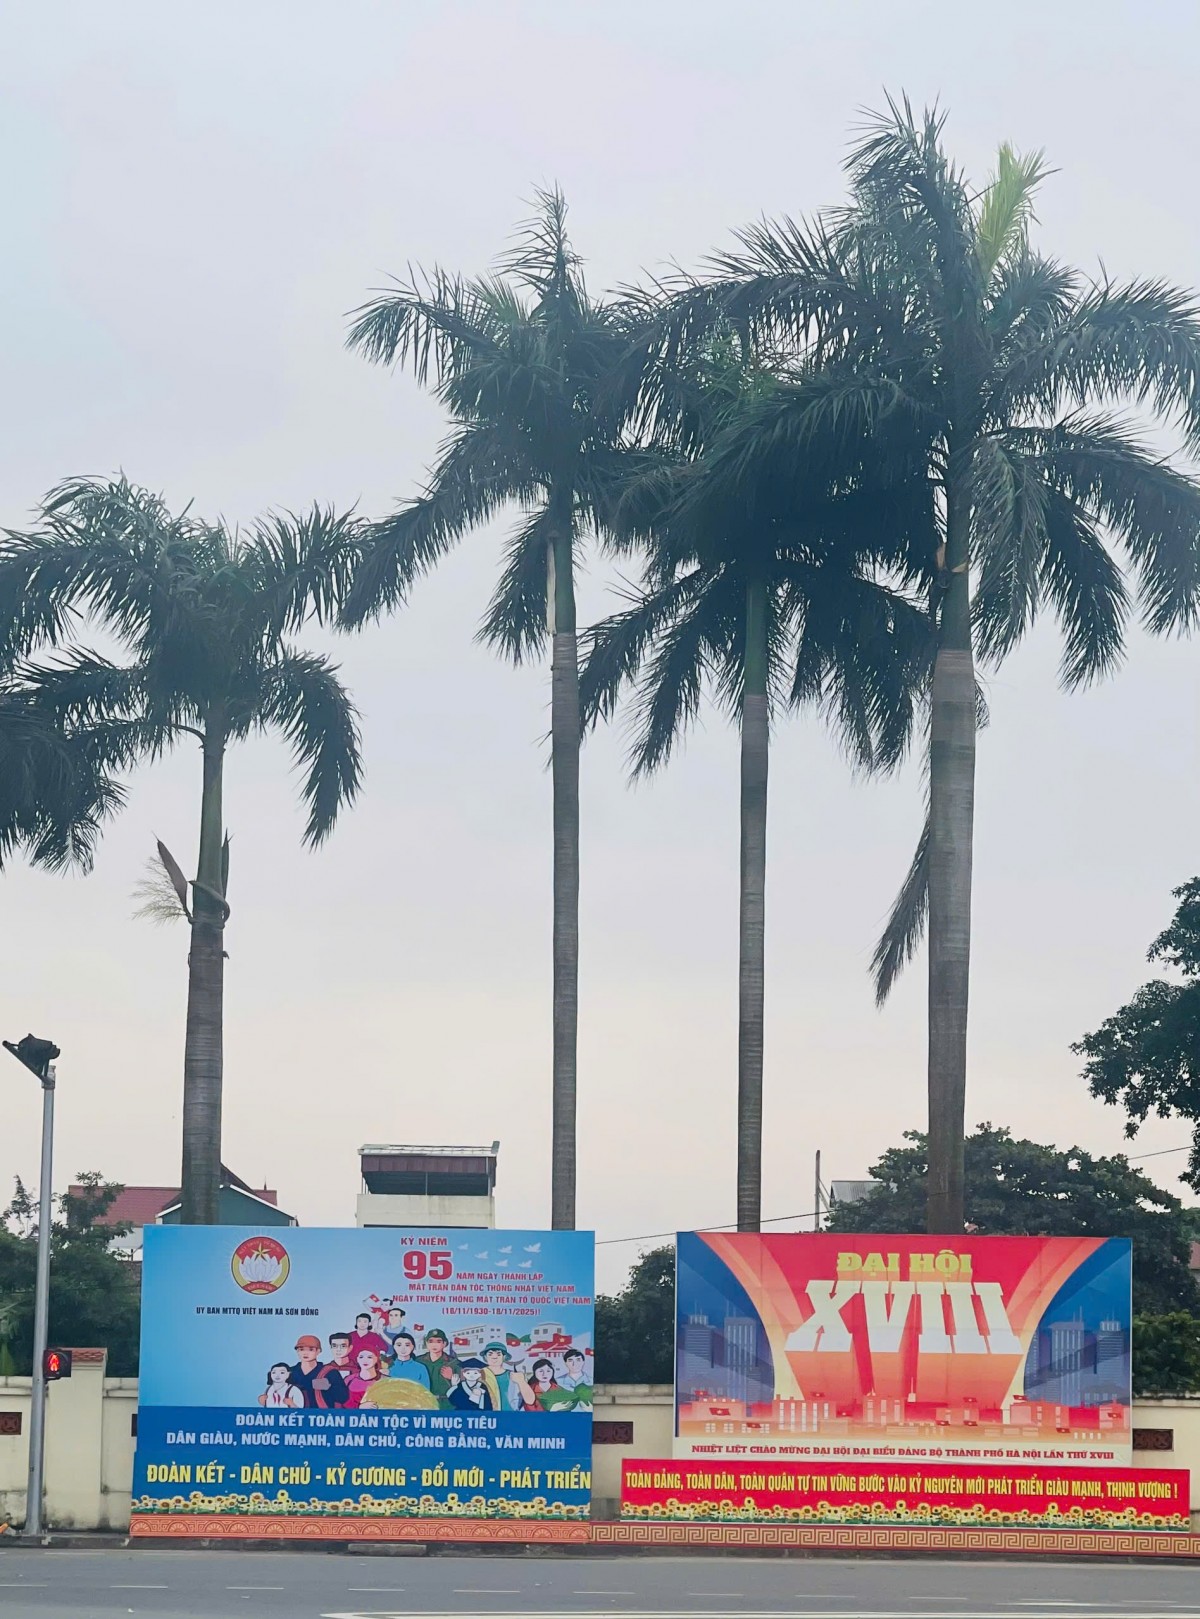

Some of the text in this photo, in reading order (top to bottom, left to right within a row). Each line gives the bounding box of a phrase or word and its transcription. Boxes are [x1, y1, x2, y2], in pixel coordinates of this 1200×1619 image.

[418, 1237, 448, 1247] NIỆM
[403, 1250, 453, 1280] 95
[837, 1249, 973, 1277] ĐẠI HỘI
[207, 1306, 220, 1314] BAN
[222, 1306, 240, 1315] MTTQ
[258, 1307, 273, 1315] NAM
[784, 1280, 1024, 1355] XVIII
[236, 1412, 497, 1431] ĐOÀN KẾT TOÀN DÂN TỘC VÌ MỤC TIÊU
[167, 1430, 565, 1450] DÂN GIÀU, NƯỚC MẠNH, DÂN CHỦ, CÔNG BẰNG, VĂN MINH
[692, 1444, 723, 1455] NHIỆT
[726, 1445, 747, 1455] LIỆT
[750, 1445, 776, 1454] CHÀO
[779, 1445, 811, 1454] MỪNG
[813, 1447, 830, 1456] ĐẠI
[833, 1446, 850, 1456] HỘI
[853, 1448, 870, 1457] ĐẠI
[873, 1445, 895, 1455] BIỂU
[898, 1446, 927, 1456] ĐẢNG
[929, 1447, 942, 1458] BỘ
[945, 1448, 980, 1457] THÀNH
[983, 1448, 1004, 1457] PHỐ
[1006, 1449, 1020, 1458] HÀ
[1022, 1449, 1041, 1460] NỘI
[1067, 1450, 1088, 1458] THỨ
[147, 1461, 191, 1482] ĐOÀN
[196, 1460, 225, 1483] KẾT
[241, 1463, 274, 1484] DÂN
[279, 1461, 311, 1485] CHỦ
[326, 1462, 347, 1485] KỶ
[352, 1466, 406, 1486] CƯƠNG
[422, 1462, 448, 1487] ĐỔI
[454, 1466, 484, 1488] MỚI
[500, 1467, 540, 1488] PHÁT
[545, 1464, 591, 1489] TRIỂN
[626, 1470, 651, 1488] TOÀN
[654, 1468, 684, 1490] ĐẢNG,
[686, 1470, 711, 1490] TOÀN
[714, 1472, 737, 1491] DÂN,
[740, 1472, 765, 1490] TOÀN
[768, 1472, 795, 1491] QUÂN
[798, 1475, 811, 1494] TỰ
[812, 1476, 828, 1491] TIN
[830, 1474, 856, 1491] VỮNG
[859, 1474, 885, 1492] BƯỚC
[888, 1474, 906, 1493] VÀO
[909, 1472, 922, 1493] KỶ
[924, 1475, 963, 1494] NGUYÊN
[966, 1476, 985, 1494] MỚI
[988, 1475, 1012, 1494] PHÁT
[1015, 1474, 1043, 1495] TRIỂN
[1046, 1477, 1068, 1496] GIÀU
[1072, 1480, 1104, 1500] MẠNH,
[1107, 1482, 1136, 1500] THỊNH
[1138, 1481, 1171, 1501] VƯỢNG
